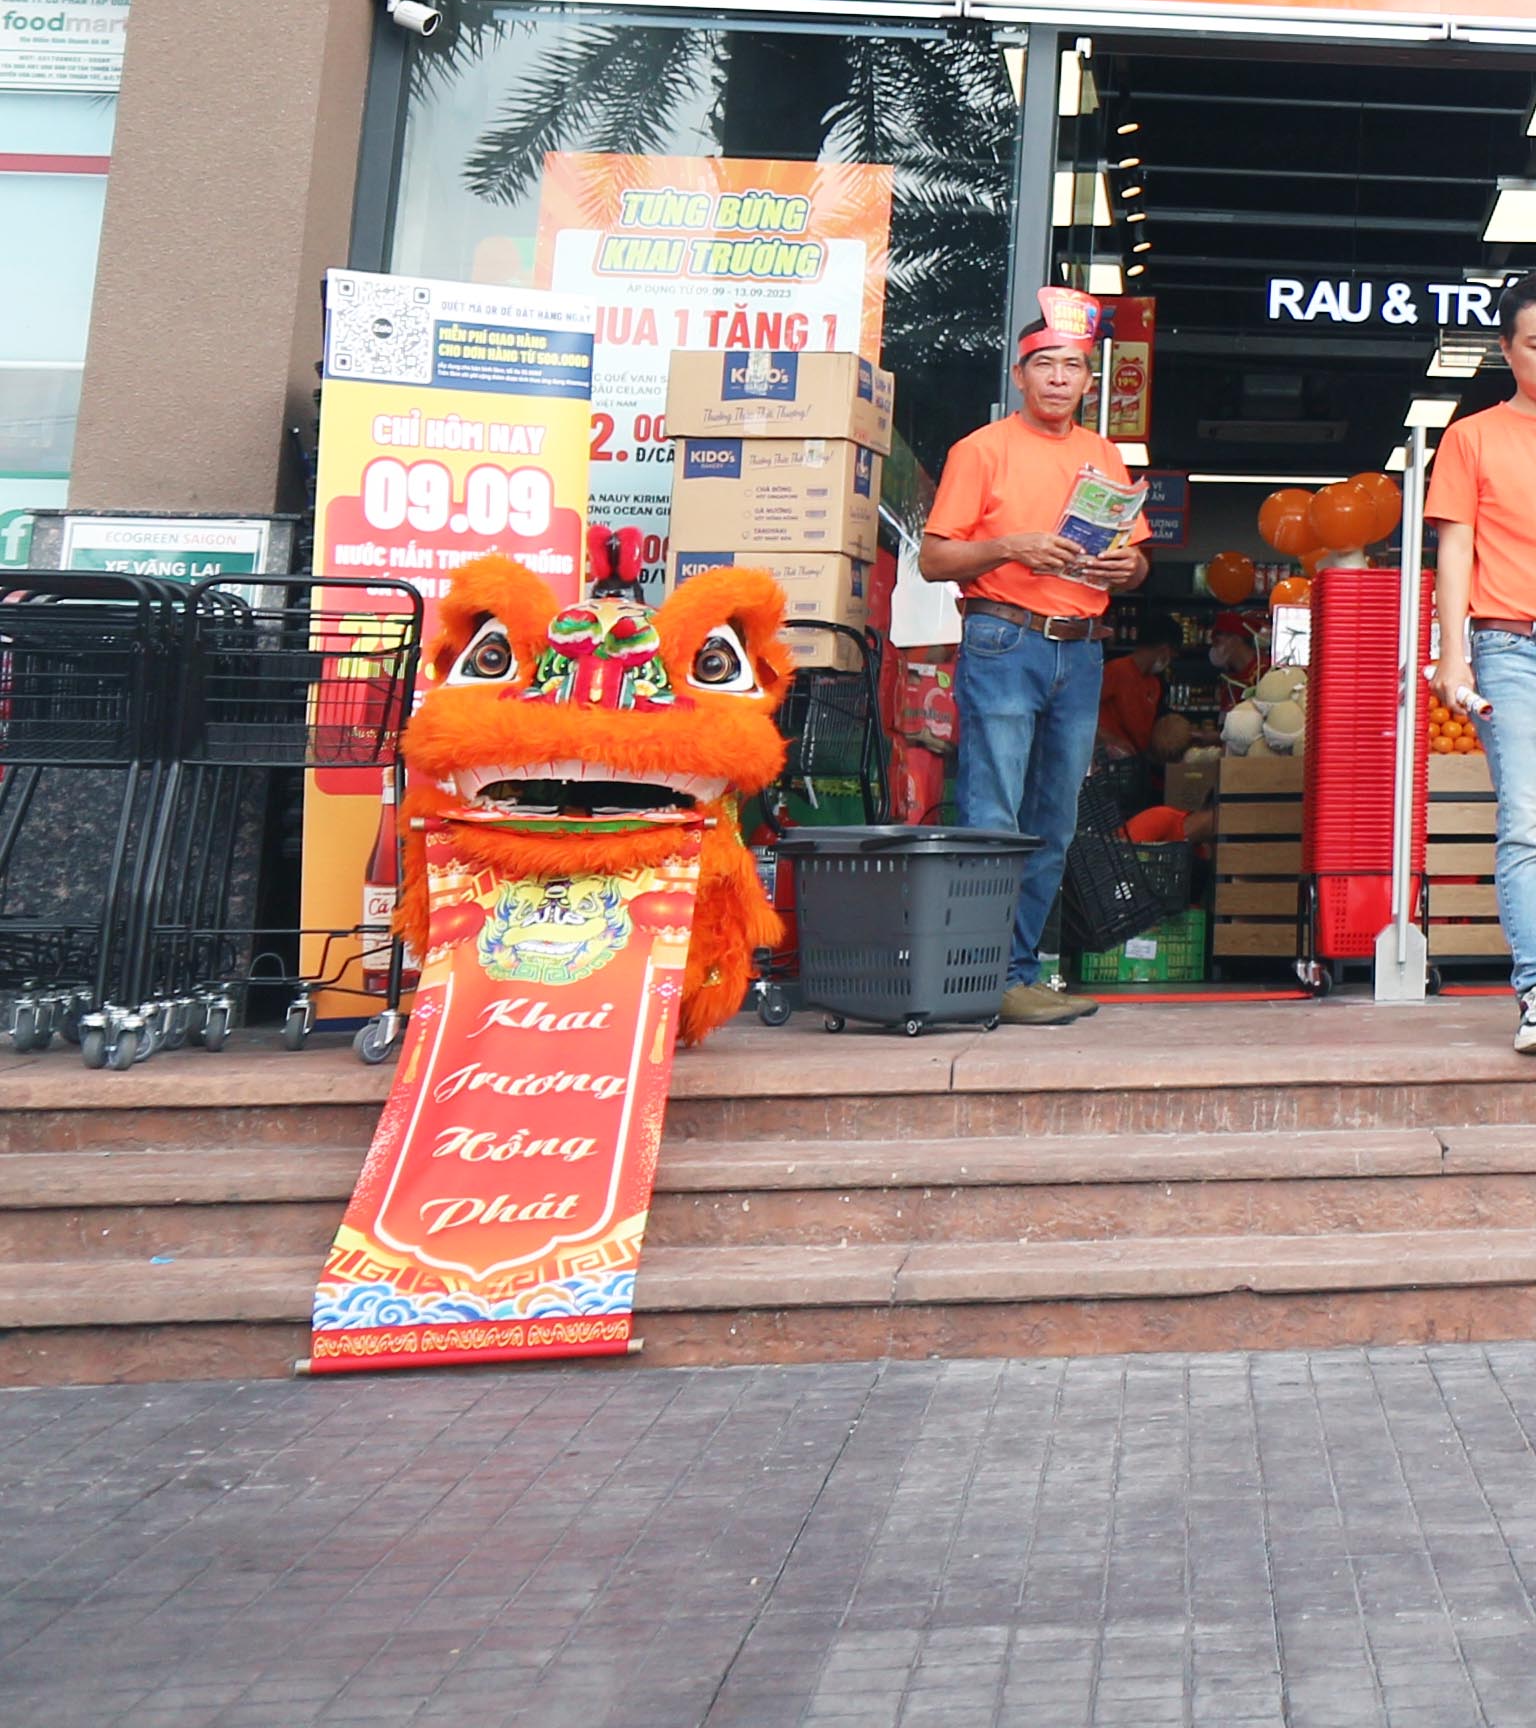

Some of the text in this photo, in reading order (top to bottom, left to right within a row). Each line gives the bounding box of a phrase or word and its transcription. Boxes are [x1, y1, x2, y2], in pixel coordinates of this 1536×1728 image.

[623, 188, 808, 231] TƯNG BỪNG
[602, 237, 822, 276] KHAI TRƯƠNG
[1268, 278, 1373, 322] RAU
[1382, 282, 1418, 324] &
[674, 308, 838, 351] 1 1
[373, 408, 546, 455] CHỈ HÔM NAY
[364, 458, 552, 537] 09.09
[613, 507, 653, 516] OCEAN
[105, 530, 238, 547] ECOGREEN SAIGON
[336, 541, 387, 566] NƯỚC
[191, 562, 221, 577] LAI
[466, 997, 613, 1039] Khai
[433, 1125, 598, 1163] Hồng
[419, 1192, 581, 1235] Phát
